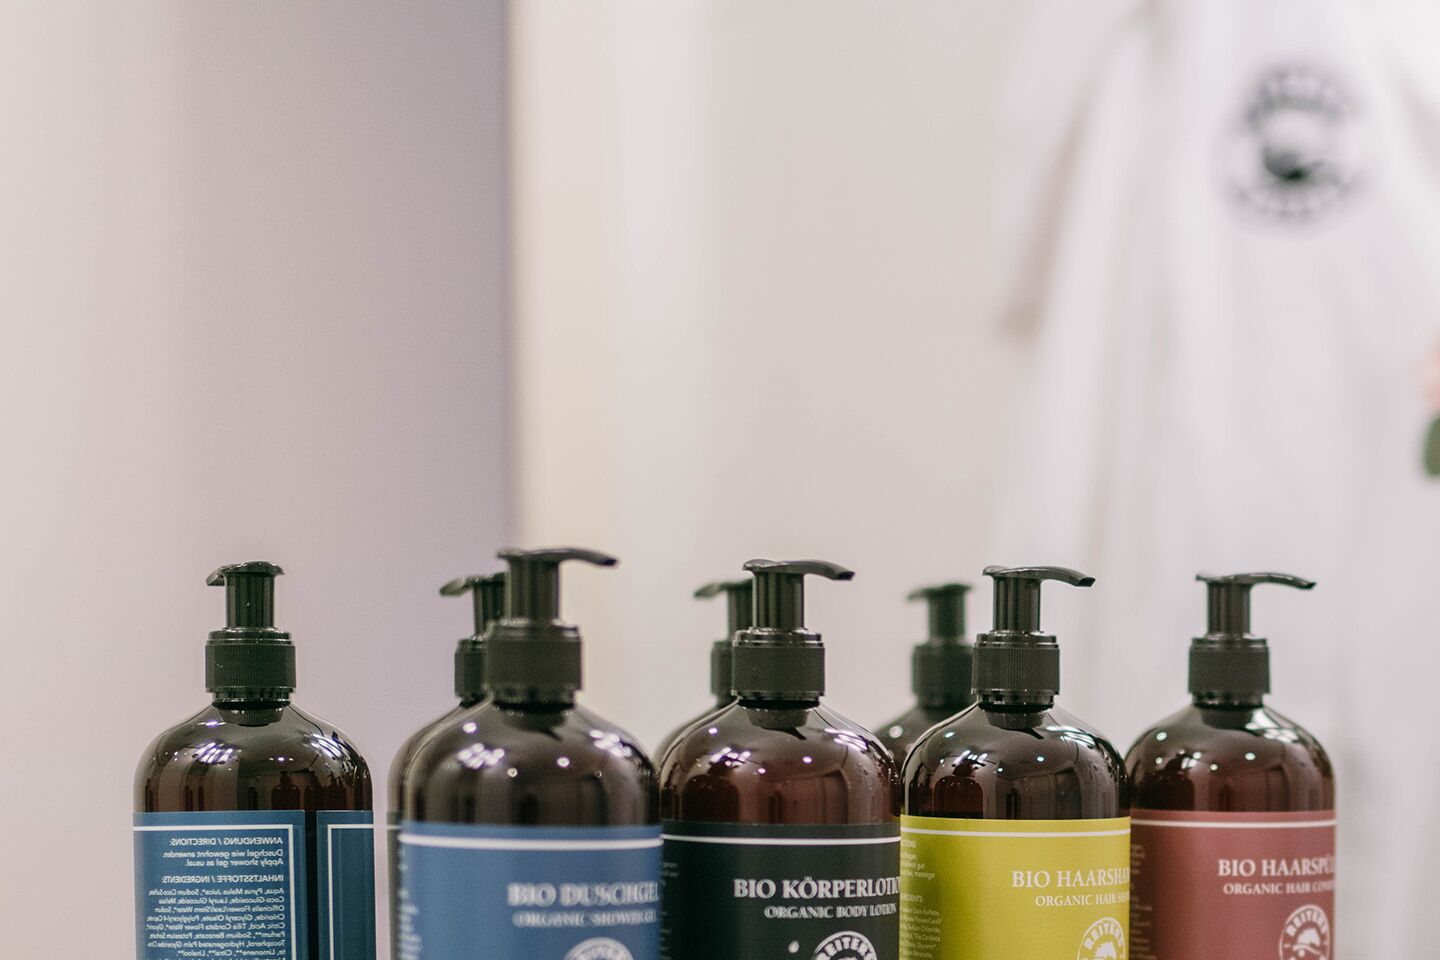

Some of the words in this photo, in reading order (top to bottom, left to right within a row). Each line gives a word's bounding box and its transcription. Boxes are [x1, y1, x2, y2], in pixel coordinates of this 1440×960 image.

[1218, 859, 1256, 876] BIO
[1012, 870, 1051, 888] BIO
[508, 882, 557, 906] BIO
[733, 879, 776, 898] BIO
[1223, 883, 1284, 895] ORGANIC
[1285, 881, 1311, 894] HAIR
[1035, 894, 1092, 906] ORGANIC
[1095, 892, 1116, 905] HAIR
[512, 910, 589, 927] ORGANIC
[764, 905, 834, 919] ORGANIC
[836, 904, 868, 918] BODY
